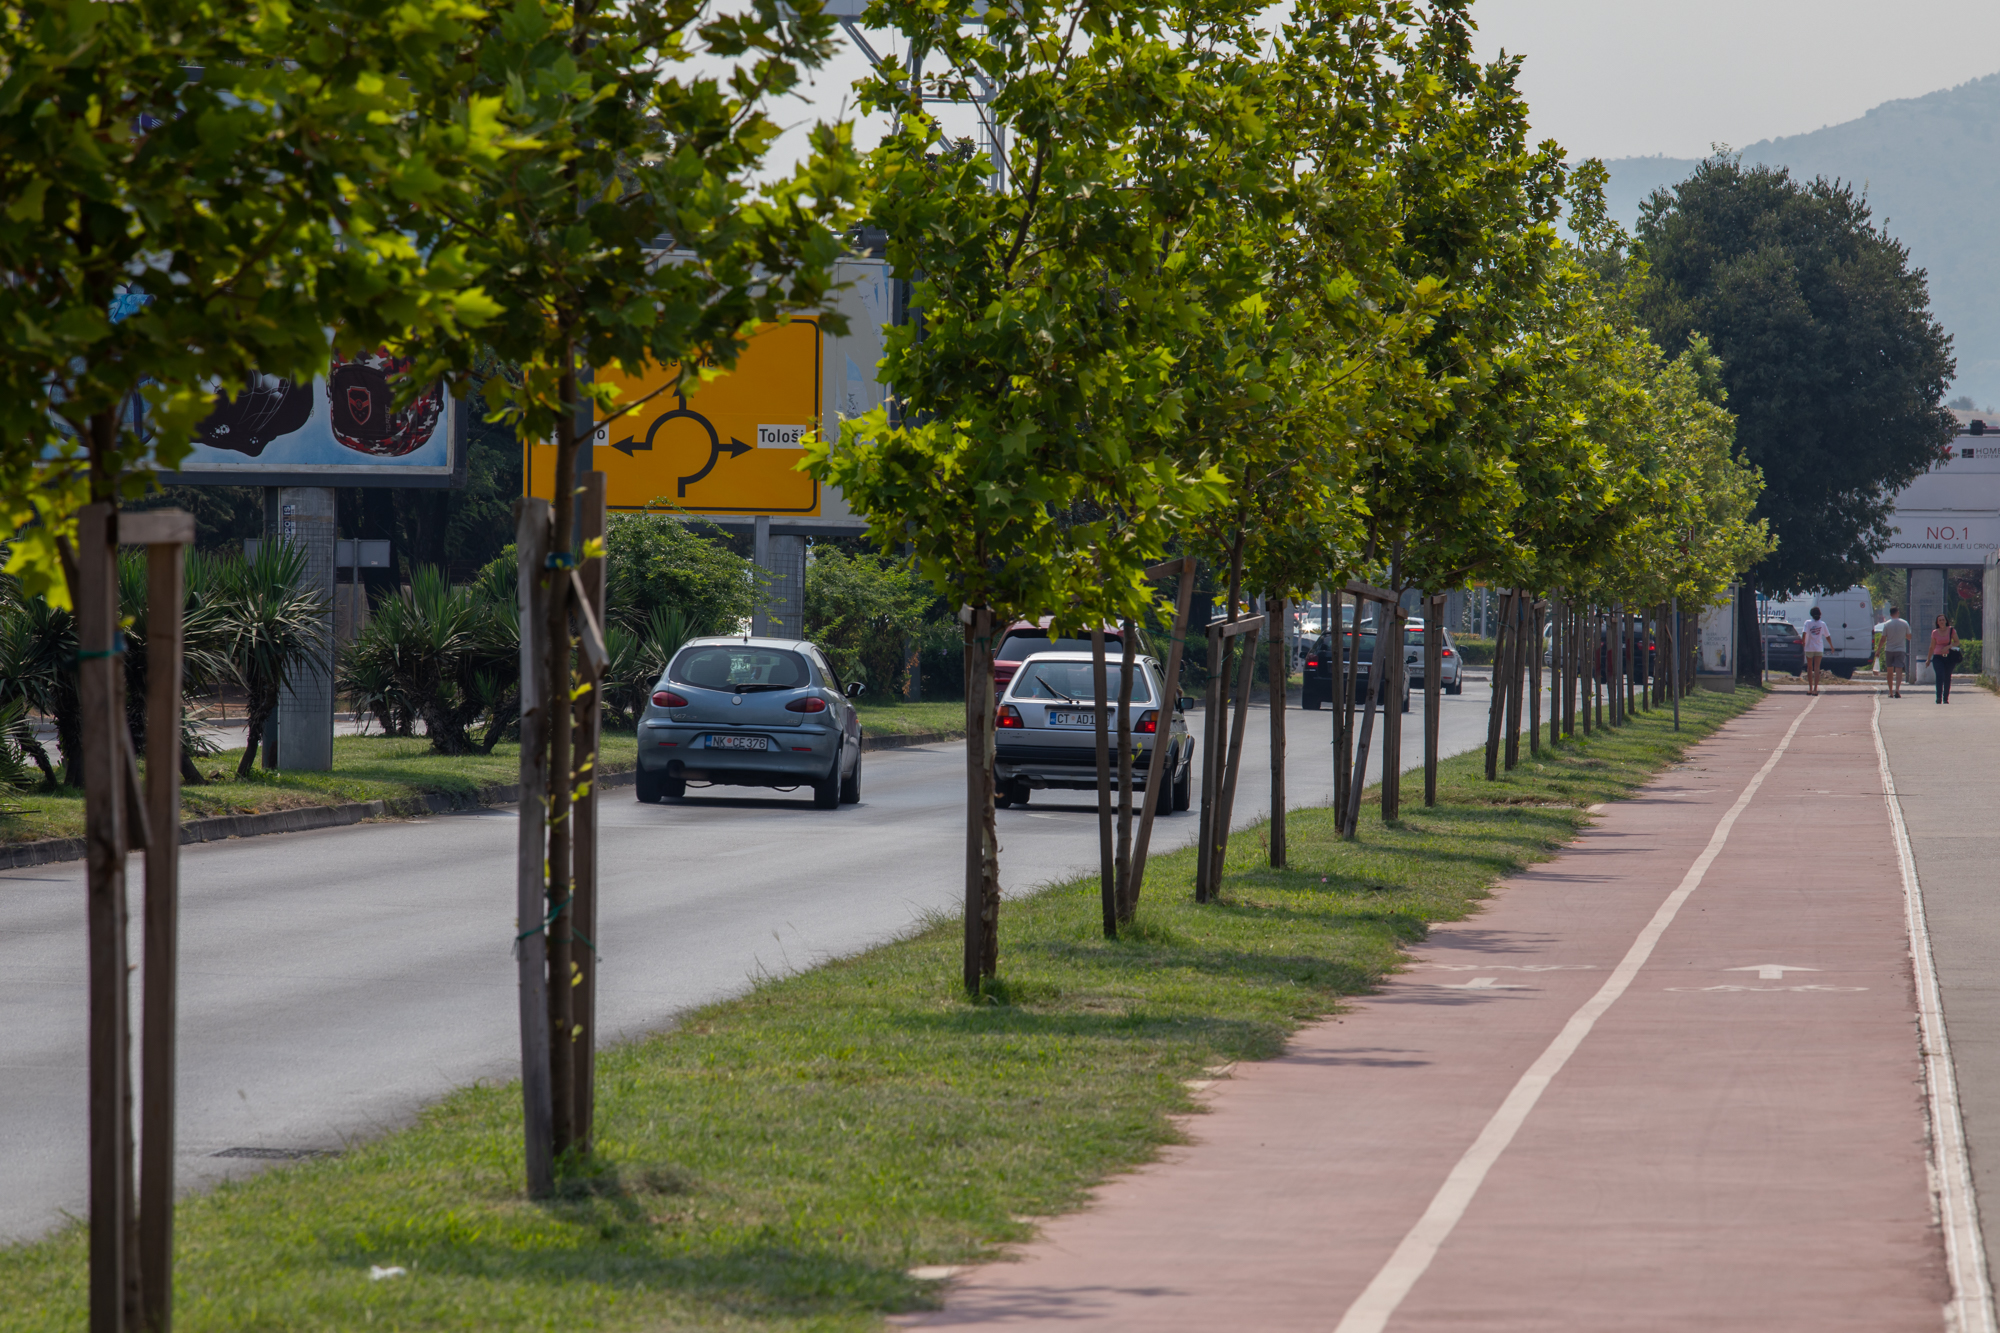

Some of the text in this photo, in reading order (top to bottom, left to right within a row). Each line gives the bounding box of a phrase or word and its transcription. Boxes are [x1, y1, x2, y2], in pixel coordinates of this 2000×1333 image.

[1926, 526, 1968, 541] NO.1
[1057, 713, 1110, 725] CT AD1
[712, 736, 726, 747] NK
